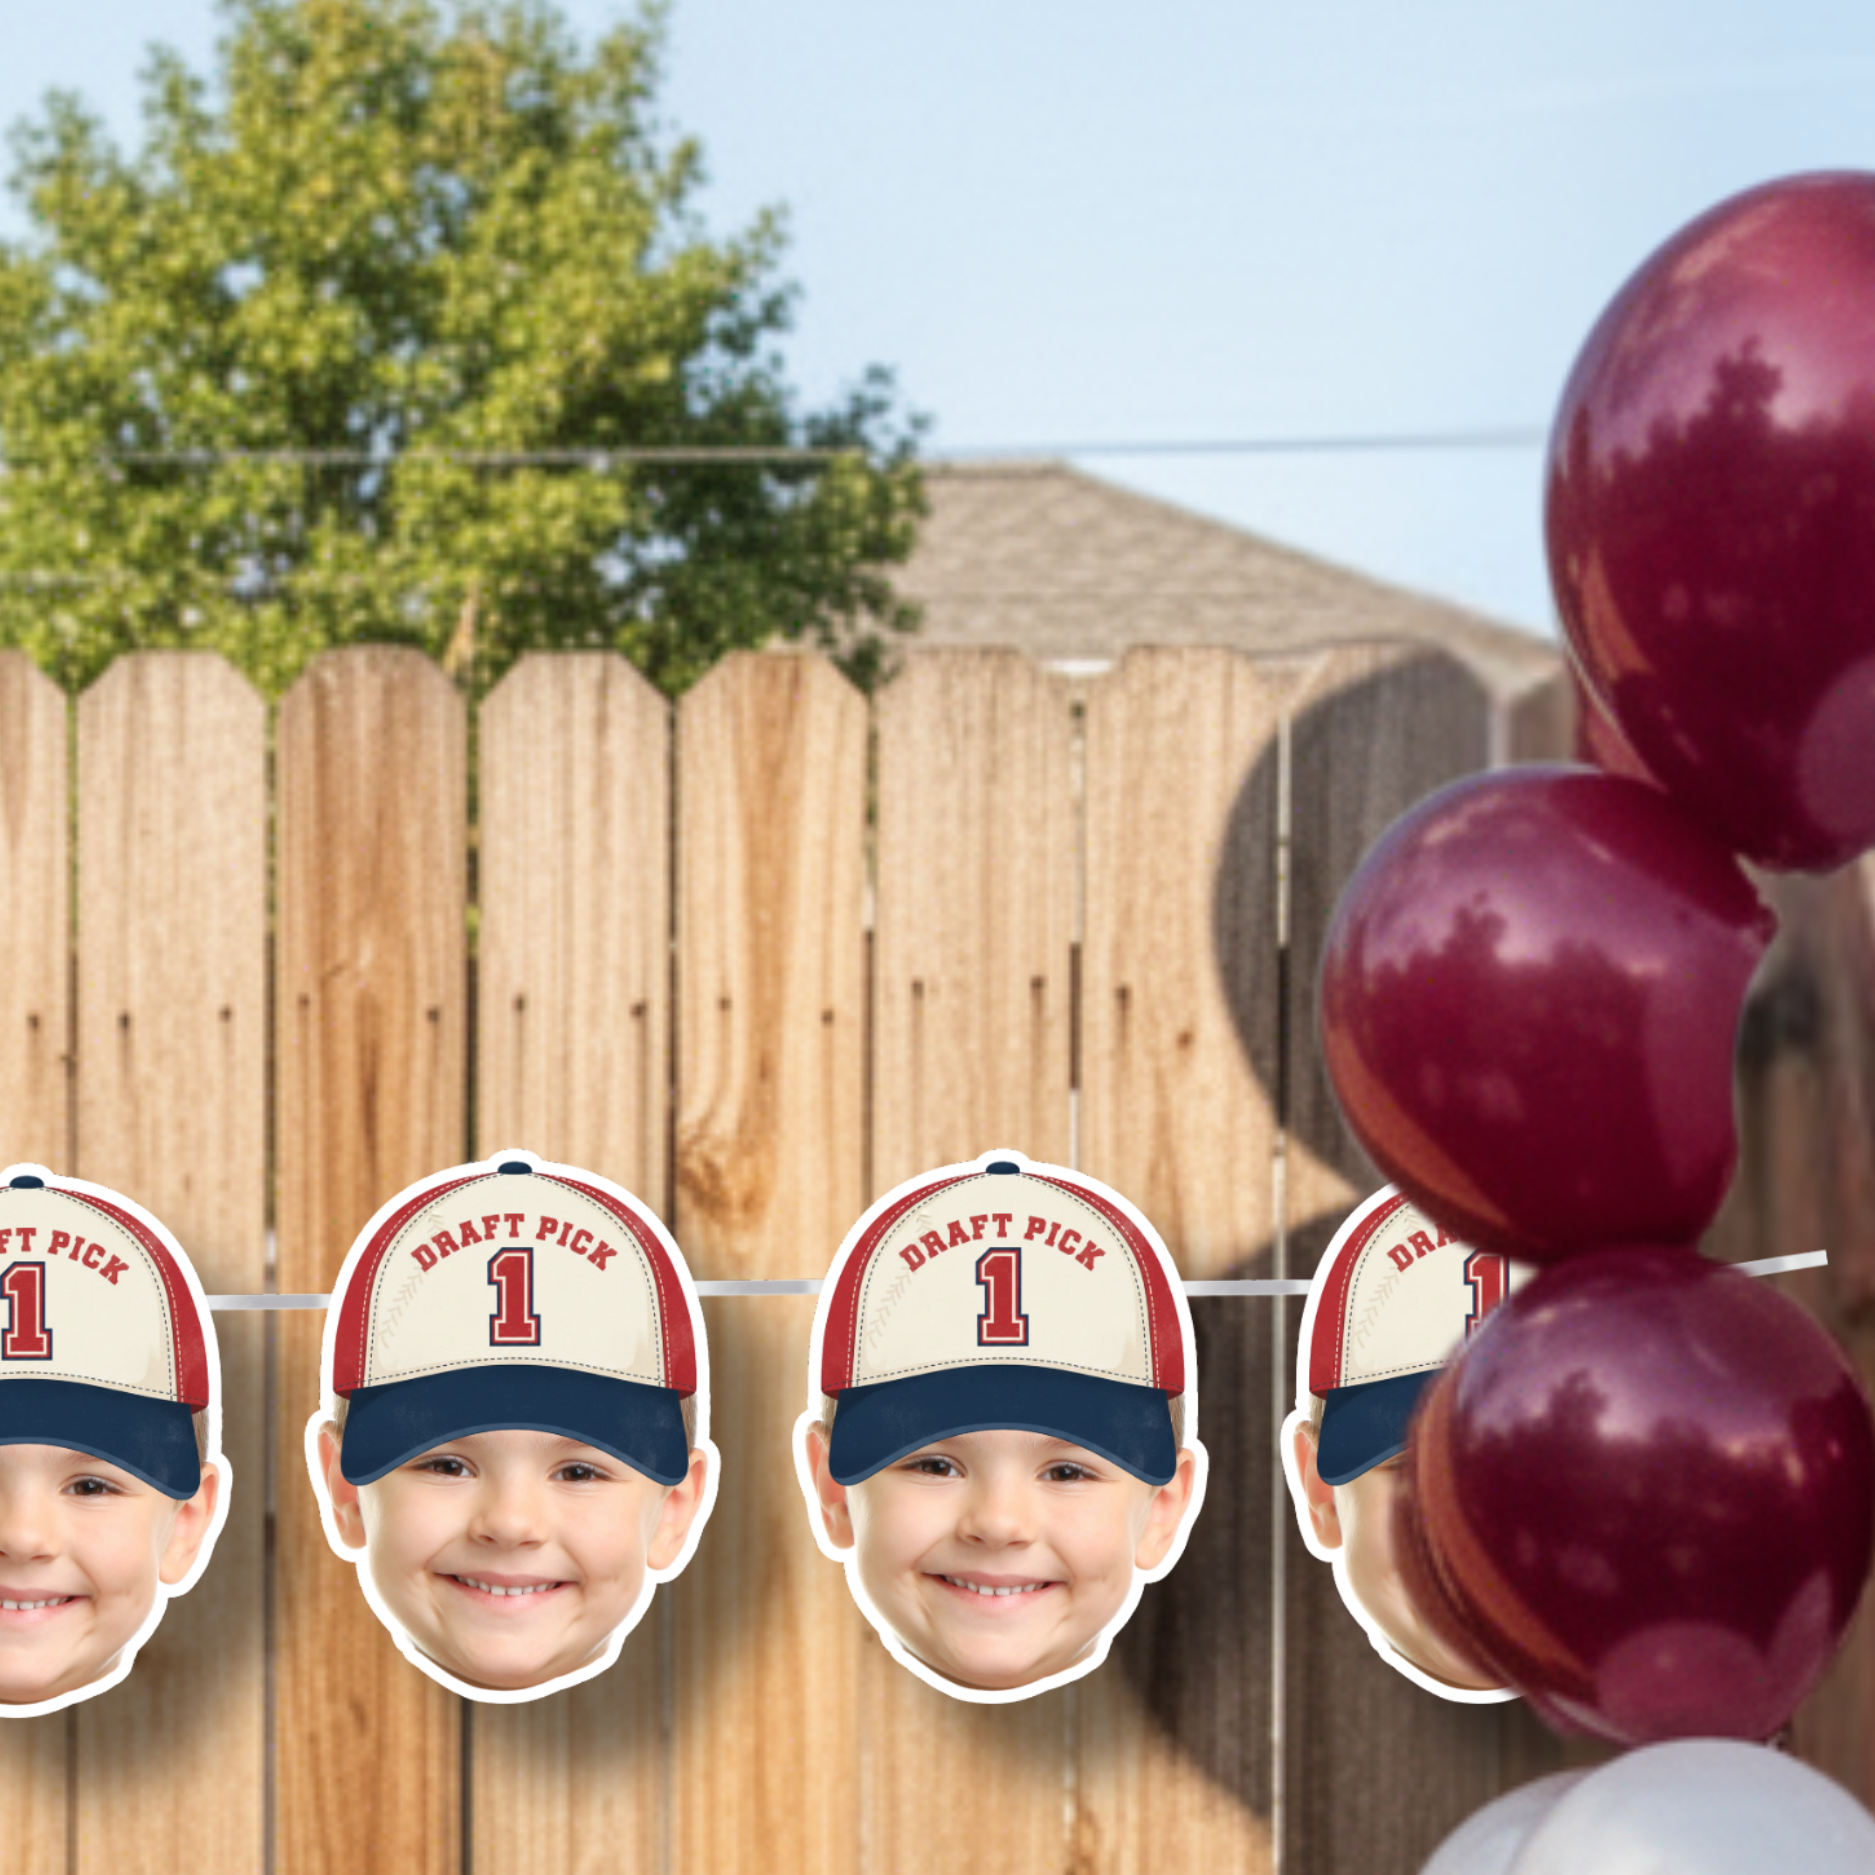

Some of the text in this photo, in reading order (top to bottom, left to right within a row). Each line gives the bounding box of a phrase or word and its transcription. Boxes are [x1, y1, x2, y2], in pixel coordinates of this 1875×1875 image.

[46, 1229, 130, 1287] PICK
[410, 1213, 618, 1273] DRAFT PICK
[899, 1213, 1107, 1273] DRAFT PICK
[1386, 1222, 1460, 1273] DRA
[0, 1261, 53, 1361] 1
[487, 1247, 541, 1347] 1
[976, 1247, 1030, 1347] 1
